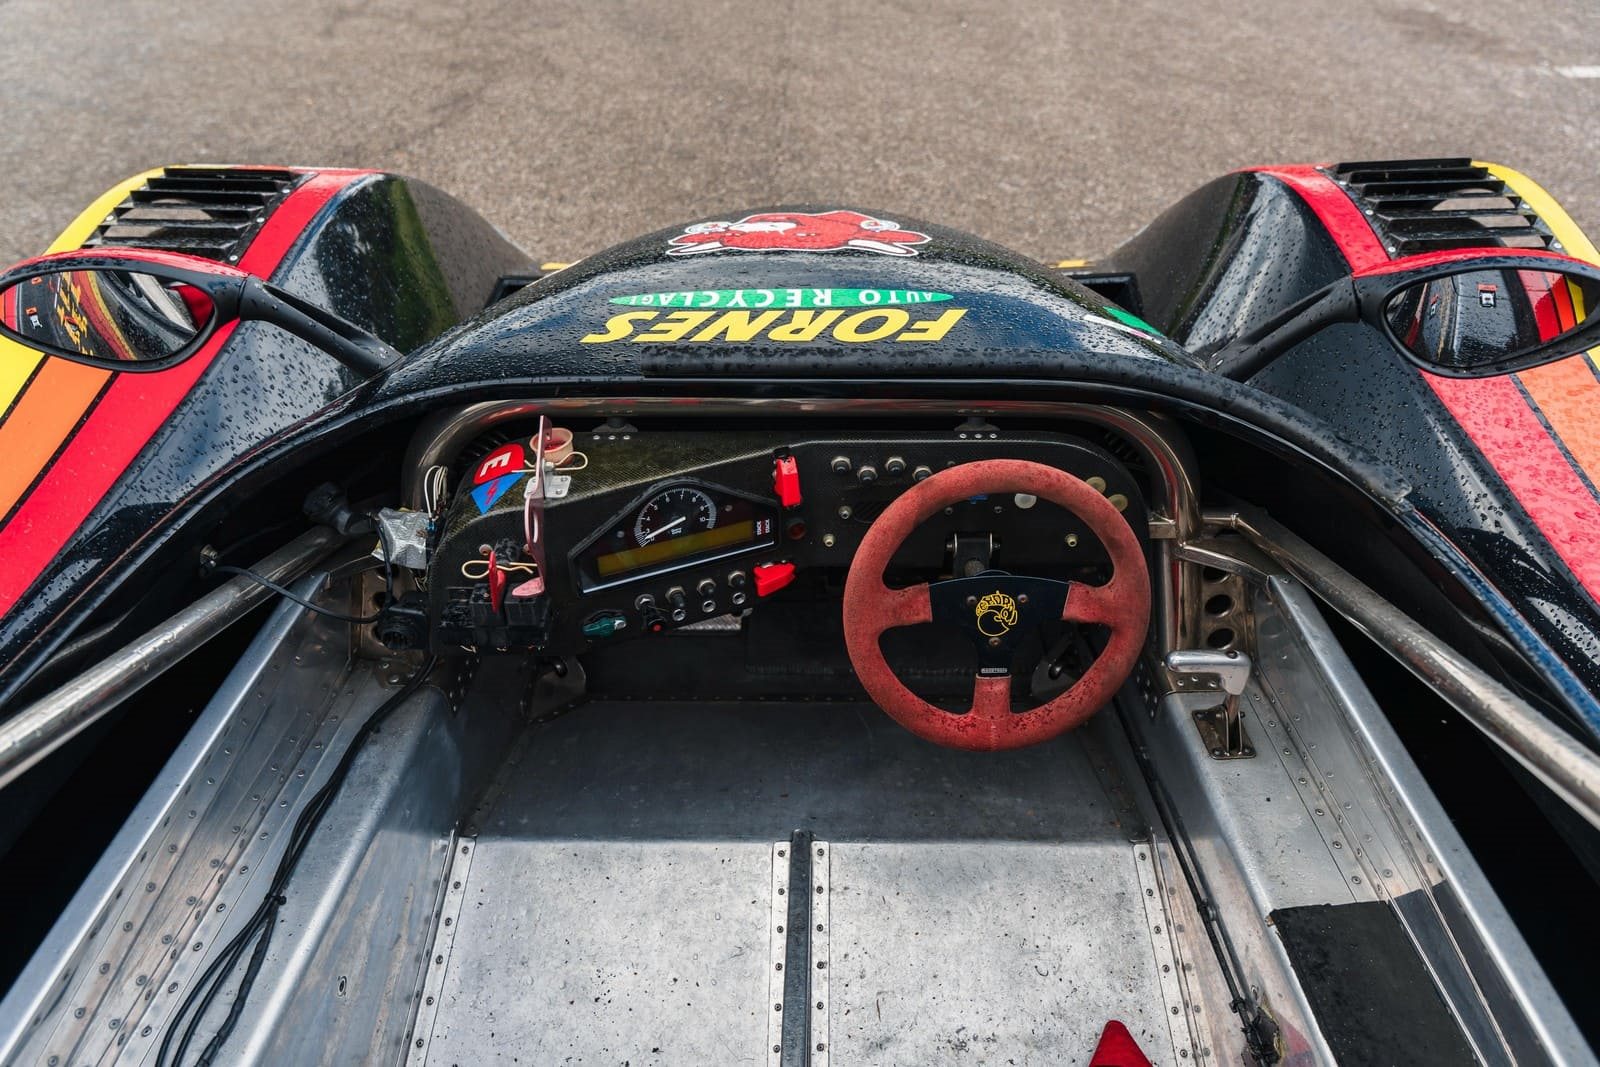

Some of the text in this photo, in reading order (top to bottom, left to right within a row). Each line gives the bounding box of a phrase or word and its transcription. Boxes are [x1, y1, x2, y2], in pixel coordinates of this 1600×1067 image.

[629, 288, 933, 308] AUTO RECYCLAGE
[579, 308, 969, 343] FORNES
